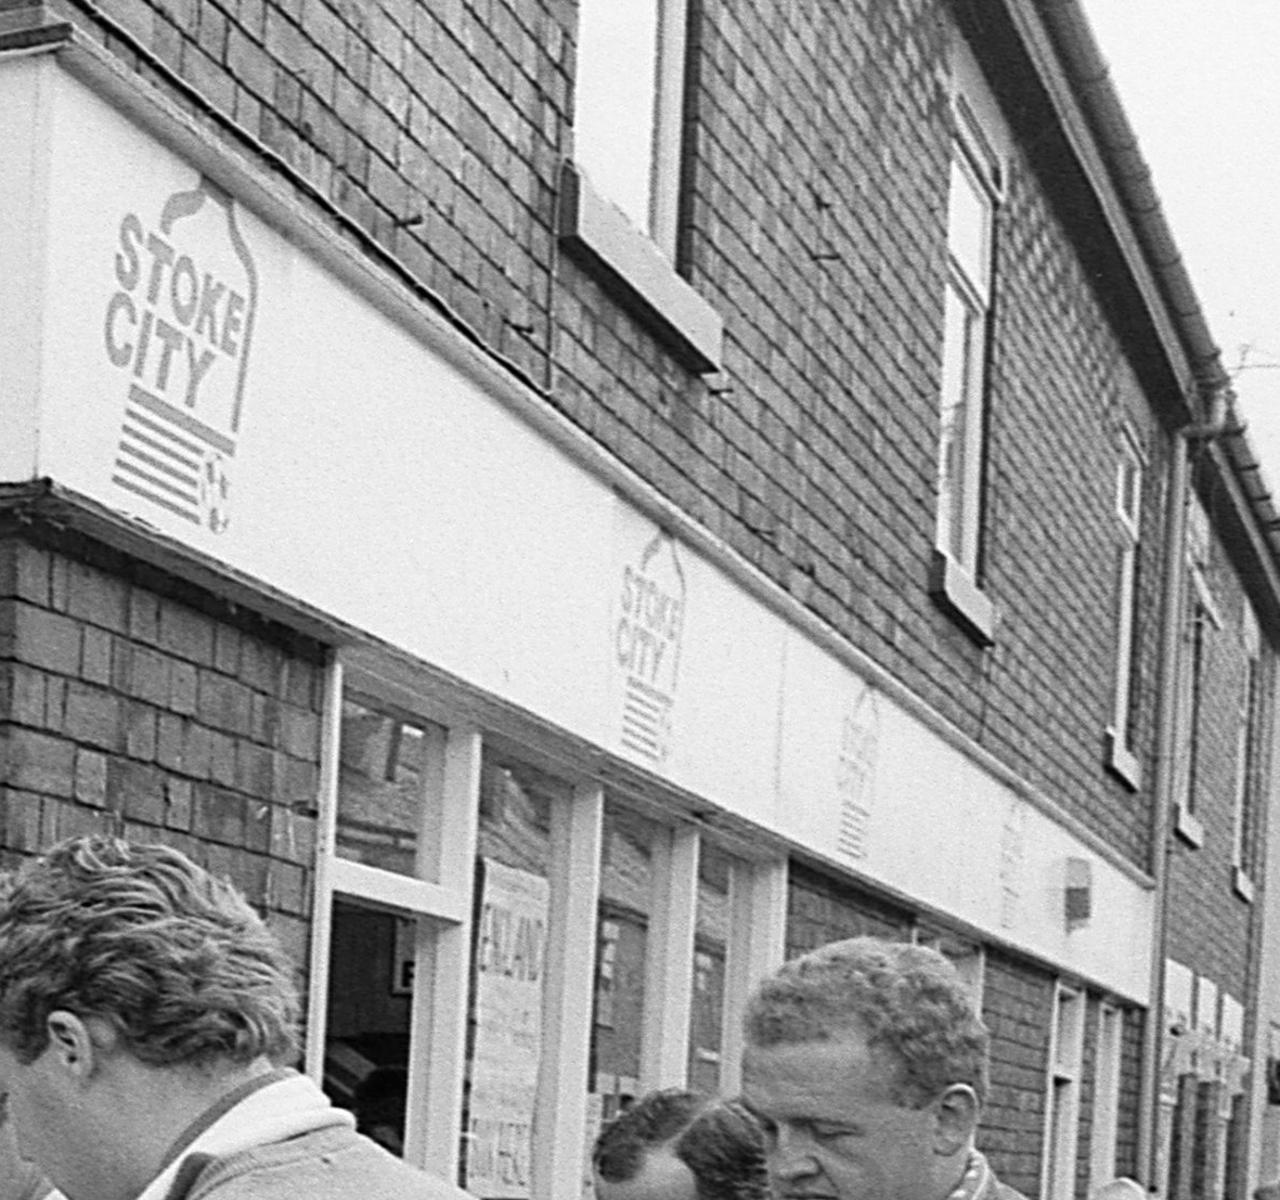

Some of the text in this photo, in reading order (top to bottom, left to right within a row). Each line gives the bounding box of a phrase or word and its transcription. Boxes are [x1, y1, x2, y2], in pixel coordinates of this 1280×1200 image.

[115, 213, 245, 357] STOKE
[104, 291, 216, 408] CITY
[616, 617, 666, 683] CITY
[621, 565, 679, 640] STOKE
